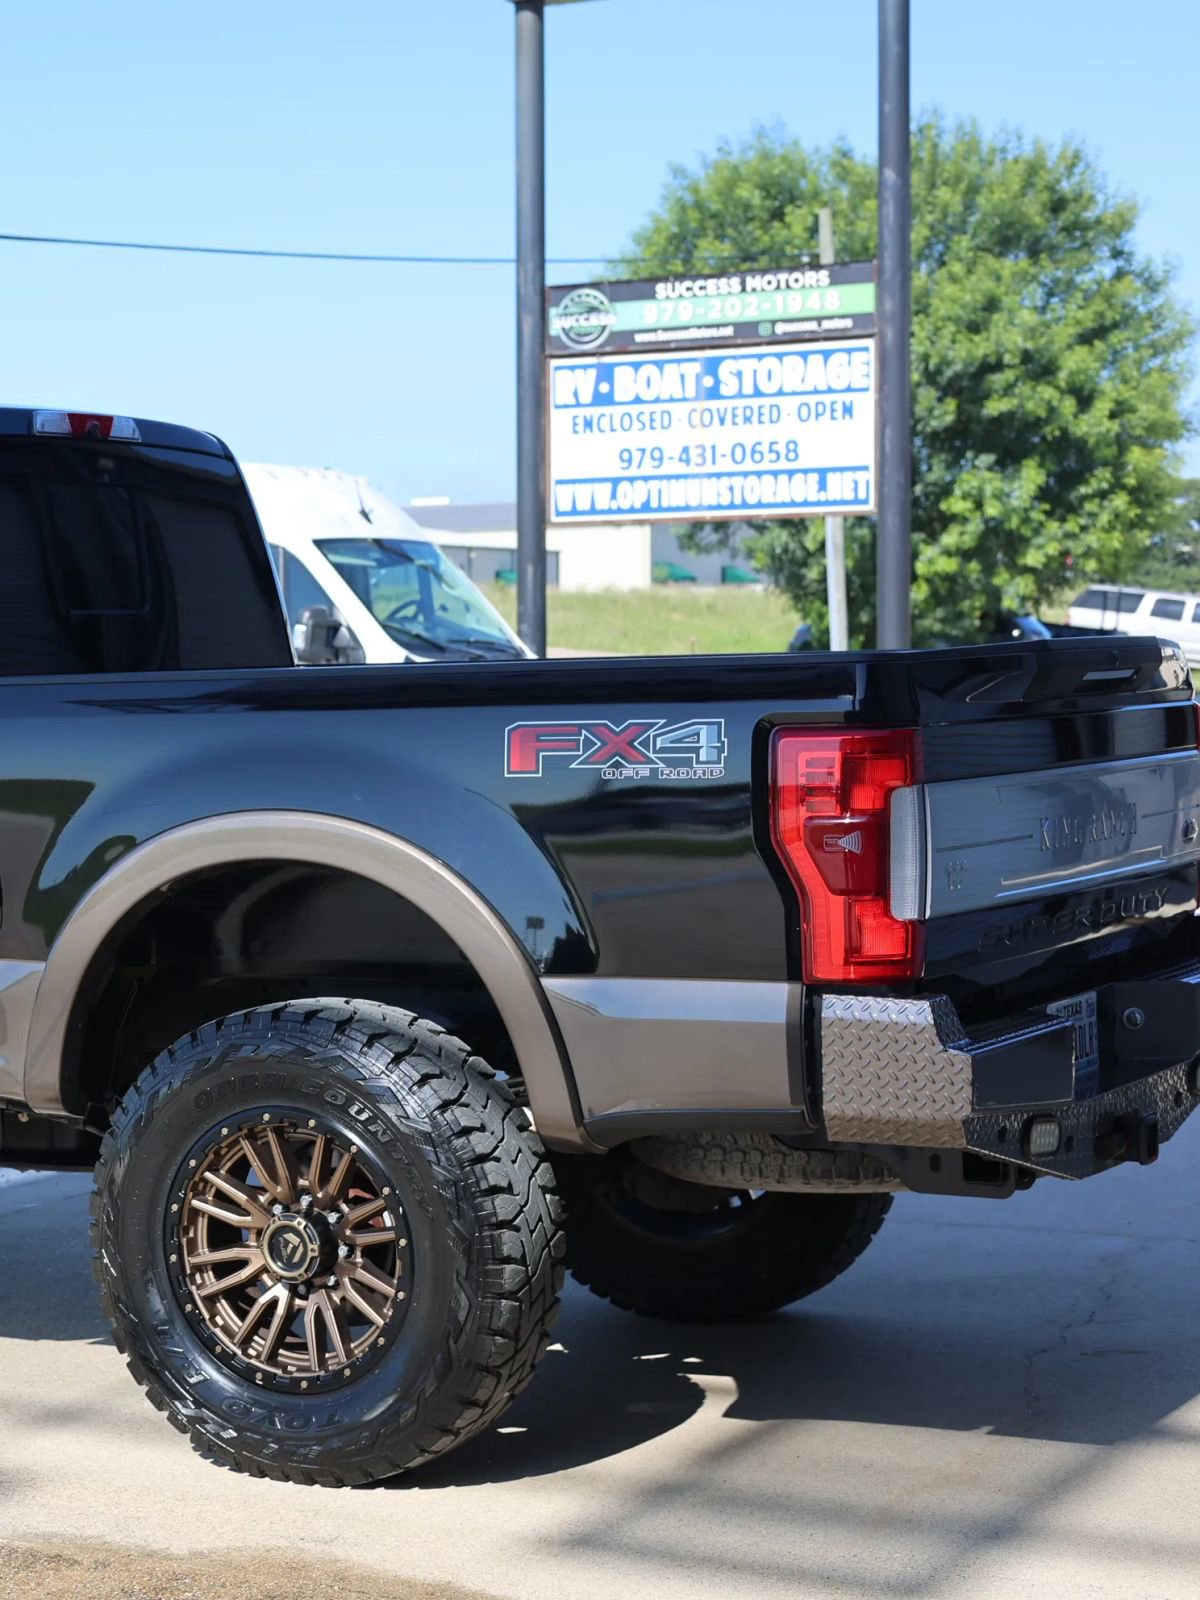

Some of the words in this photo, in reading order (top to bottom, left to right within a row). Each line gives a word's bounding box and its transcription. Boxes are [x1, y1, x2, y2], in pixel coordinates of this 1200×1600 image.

[655, 275, 742, 299] SUCCESS
[746, 270, 831, 293] MOTORS
[551, 312, 617, 330] SUCCESS
[642, 291, 841, 325] 979-202-1948
[554, 369, 597, 405] RV
[614, 362, 701, 402] BOAT
[718, 351, 870, 396] STORAGE
[573, 410, 672, 434] ENCLOSED
[688, 404, 781, 429] COVERED
[797, 400, 854, 423] OPEN
[619, 440, 800, 470] 979-431-0658
[504, 719, 727, 777] FX4
[601, 768, 650, 779] OFF
[659, 768, 725, 779] ROAD
[1040, 816, 1082, 851] KING
[1088, 803, 1137, 843] RANCH
[1100, 884, 1170, 923] DUTY
[1064, 1000, 1083, 1018] TEXAS
[222, 1397, 344, 1434] TOYO
